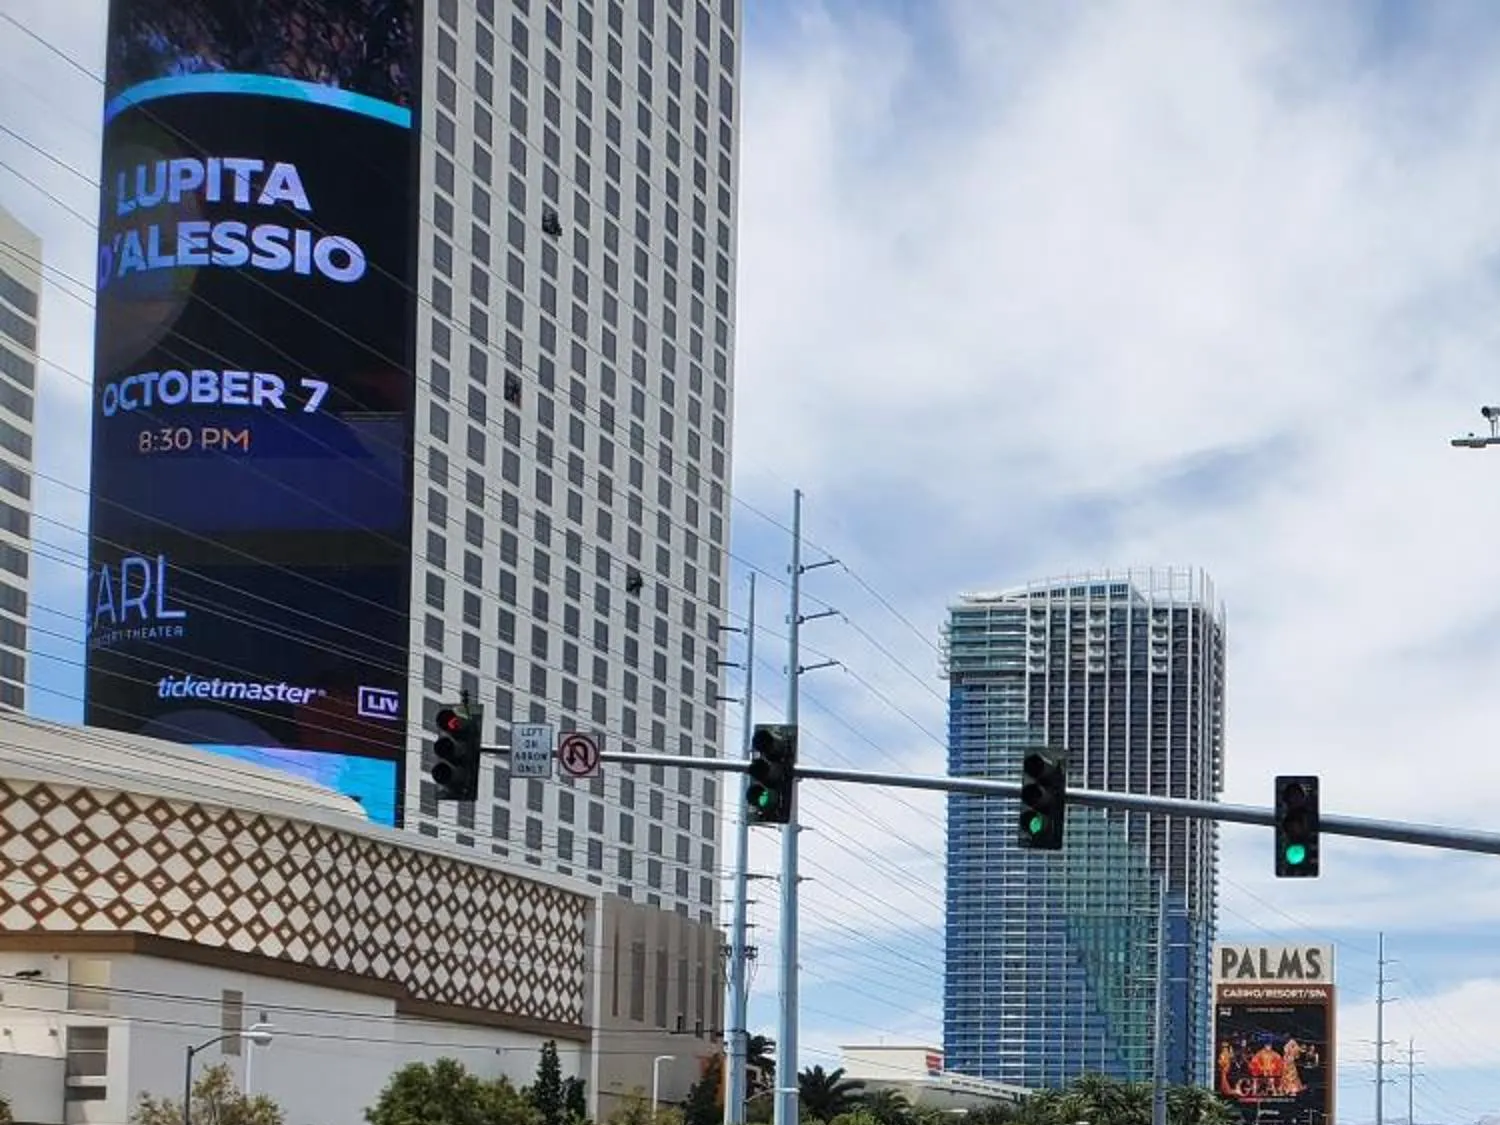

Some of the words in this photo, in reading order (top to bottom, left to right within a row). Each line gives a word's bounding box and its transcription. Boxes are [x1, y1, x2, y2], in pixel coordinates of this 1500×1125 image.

[116, 157, 313, 215] LUPITA
[97, 220, 367, 290] D'ALESSIO
[102, 369, 287, 417] OCTOBER
[300, 377, 330, 413] 7
[139, 427, 193, 453] 8:30
[201, 427, 250, 453] PM
[88, 555, 187, 629] ARL
[157, 675, 317, 705] ticketmaster
[521, 727, 543, 736] LEFT
[525, 739, 538, 749] ON
[515, 751, 548, 761] ARROW
[518, 764, 544, 774] ONLY
[1221, 947, 1322, 979] PALMS
